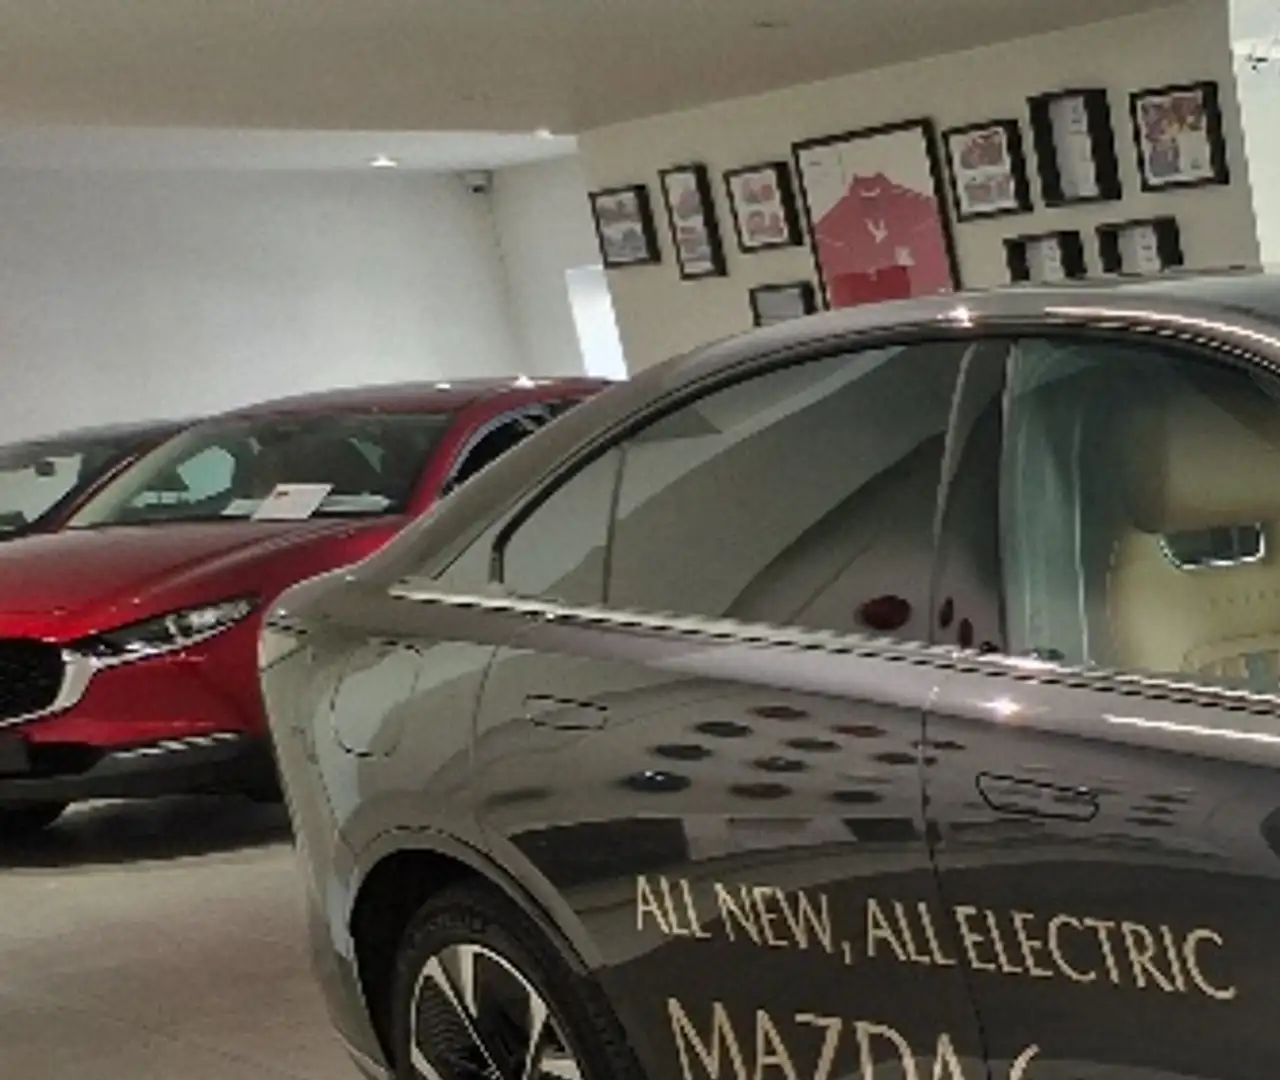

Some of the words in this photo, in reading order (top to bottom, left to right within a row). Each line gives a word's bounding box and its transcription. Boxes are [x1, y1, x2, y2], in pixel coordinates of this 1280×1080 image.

[635, 875, 709, 939] ALL
[715, 882, 853, 965] NEW,
[866, 897, 957, 966] ALL
[955, 905, 1238, 1001] ELECTRIC
